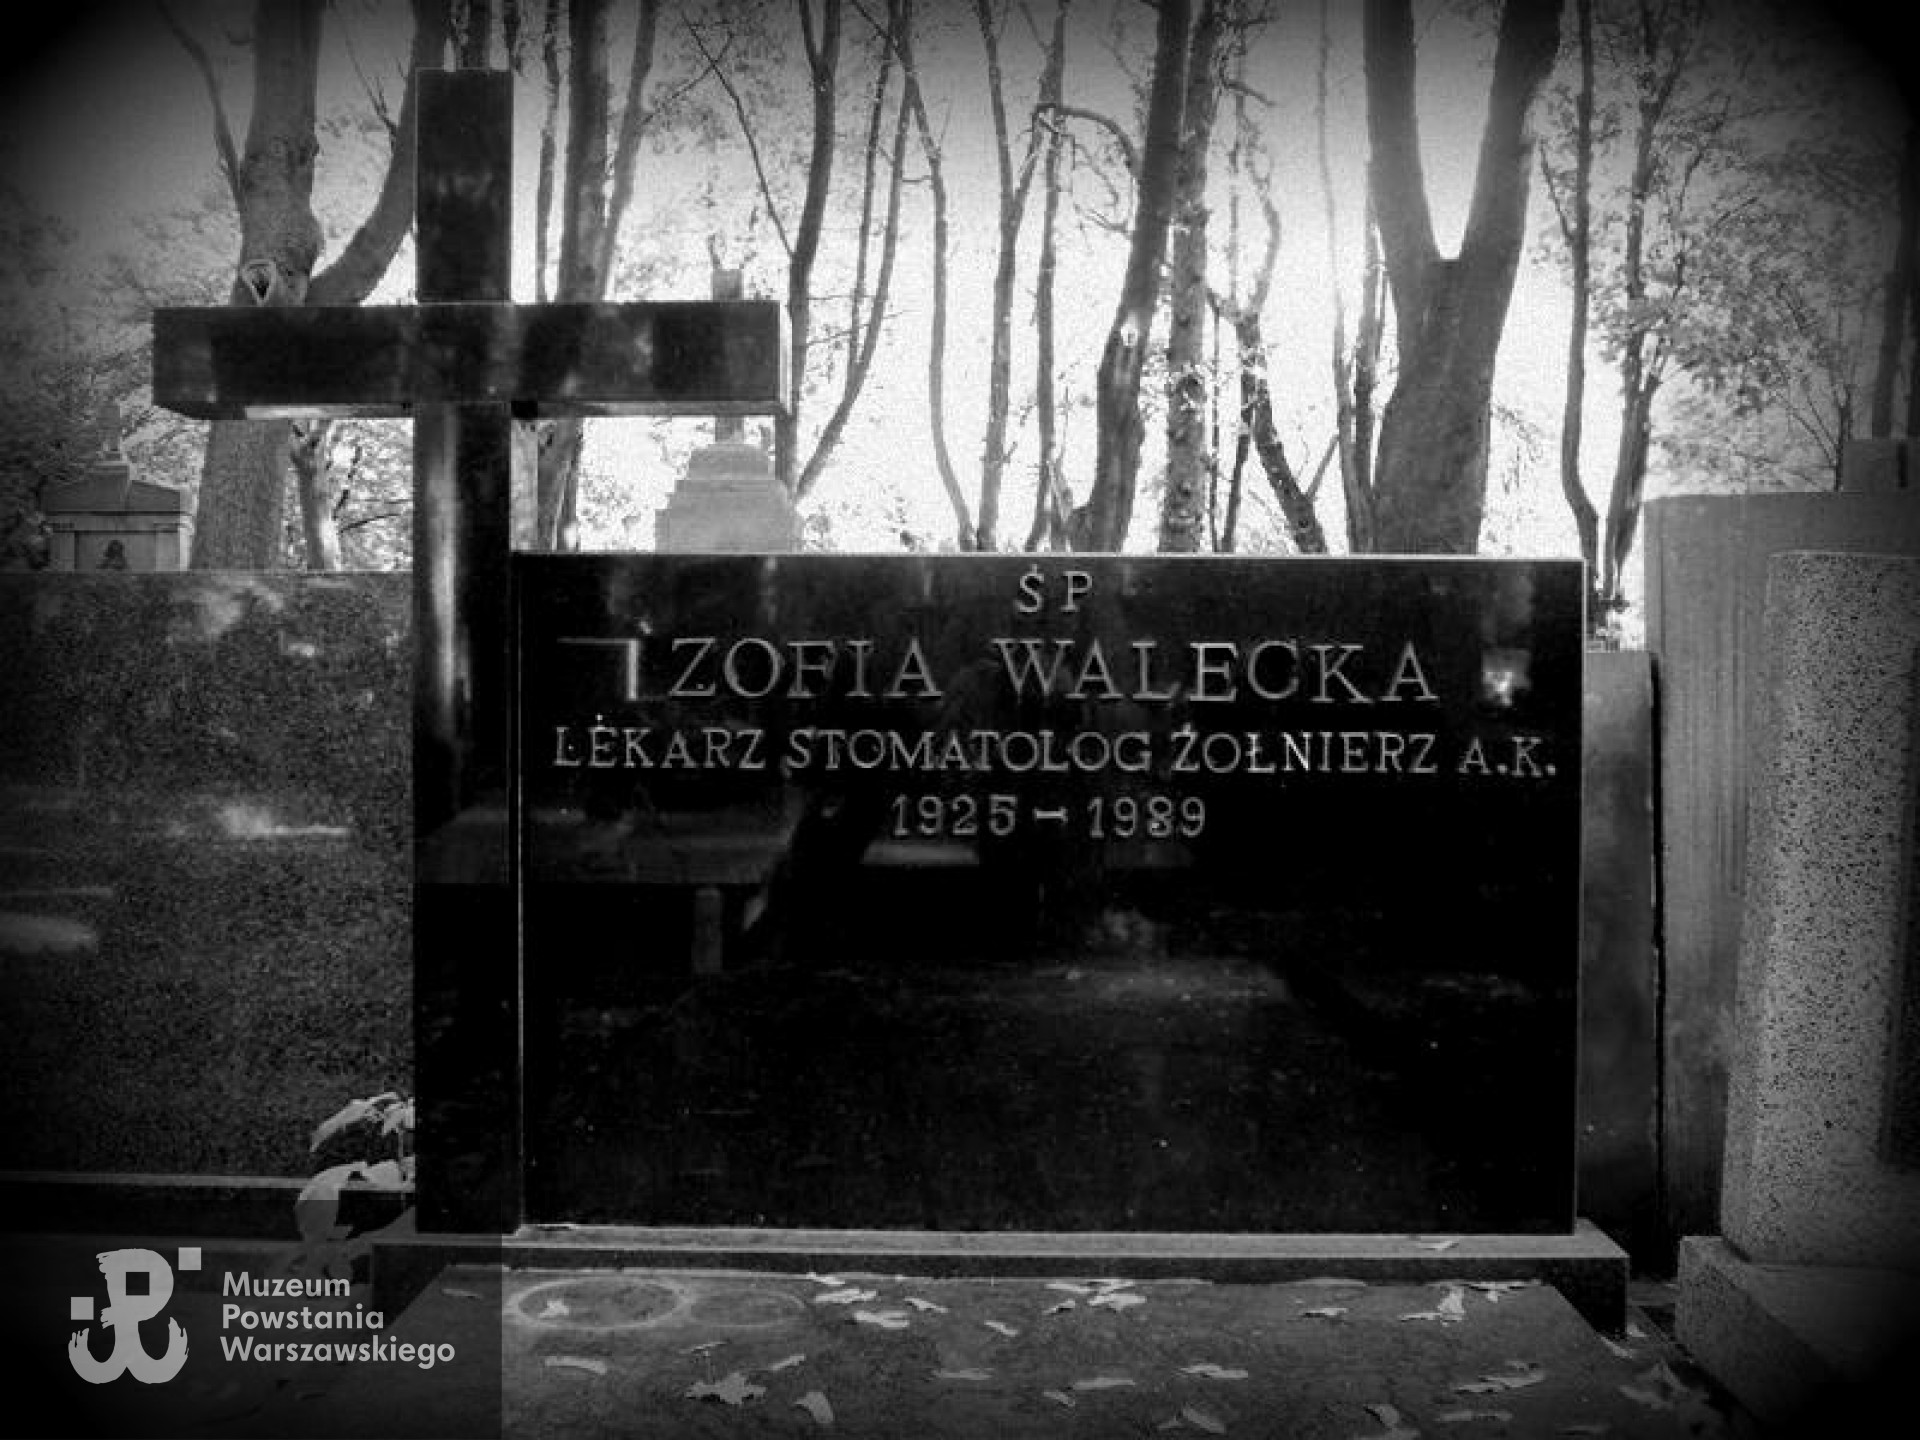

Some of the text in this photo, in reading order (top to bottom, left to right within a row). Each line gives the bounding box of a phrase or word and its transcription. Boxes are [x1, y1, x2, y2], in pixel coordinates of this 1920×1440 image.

[668, 636, 1440, 704] ZOFIA WALECKA
[553, 724, 766, 770] LEKARZ
[785, 727, 1152, 773] STOMATOLOG
[1170, 722, 1439, 775] ŻOŁNIERZ
[891, 794, 1018, 837] 1925
[1086, 796, 1206, 838] 1989
